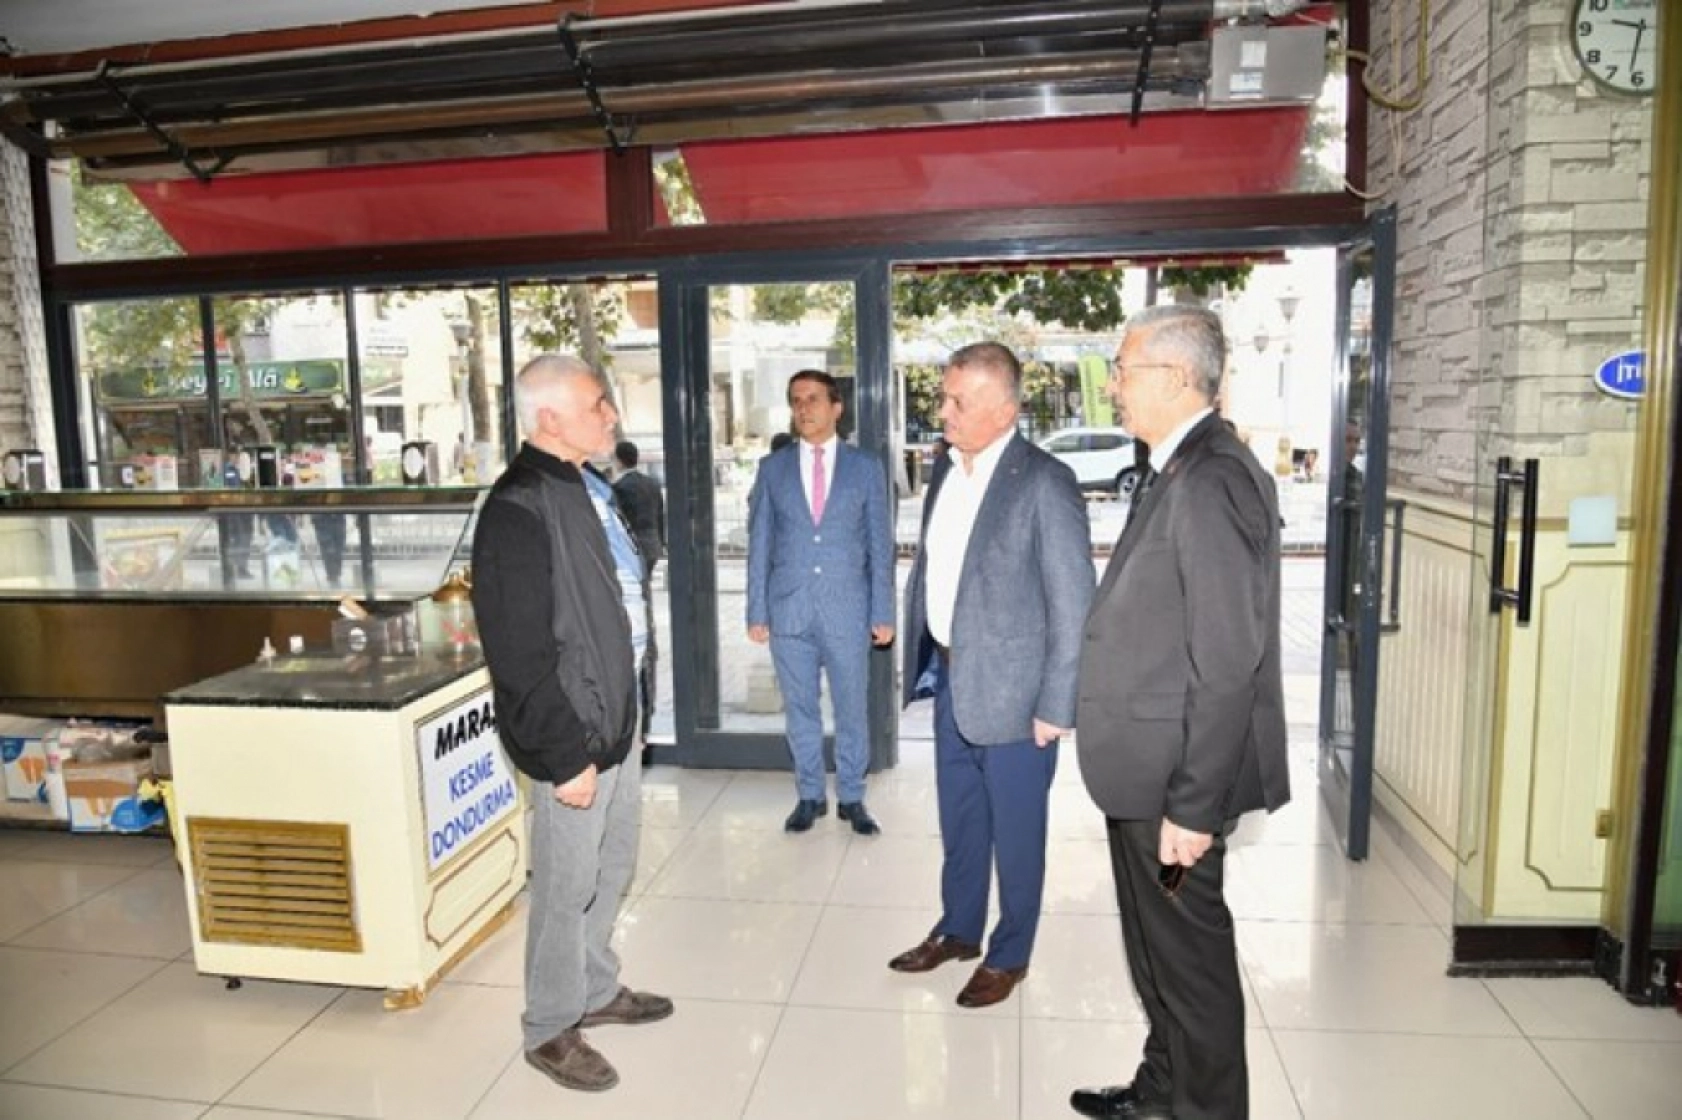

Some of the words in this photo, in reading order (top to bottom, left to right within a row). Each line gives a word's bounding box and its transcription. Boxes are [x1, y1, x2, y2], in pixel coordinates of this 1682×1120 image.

[1588, 0, 1608, 12] 10
[1579, 21, 1592, 37] 9
[1587, 50, 1601, 64] 8
[1605, 65, 1618, 80] 7
[1631, 71, 1645, 87] 6
[434, 702, 499, 760] MARA
[449, 751, 495, 802] KESME
[432, 778, 514, 859] DONDURMA
